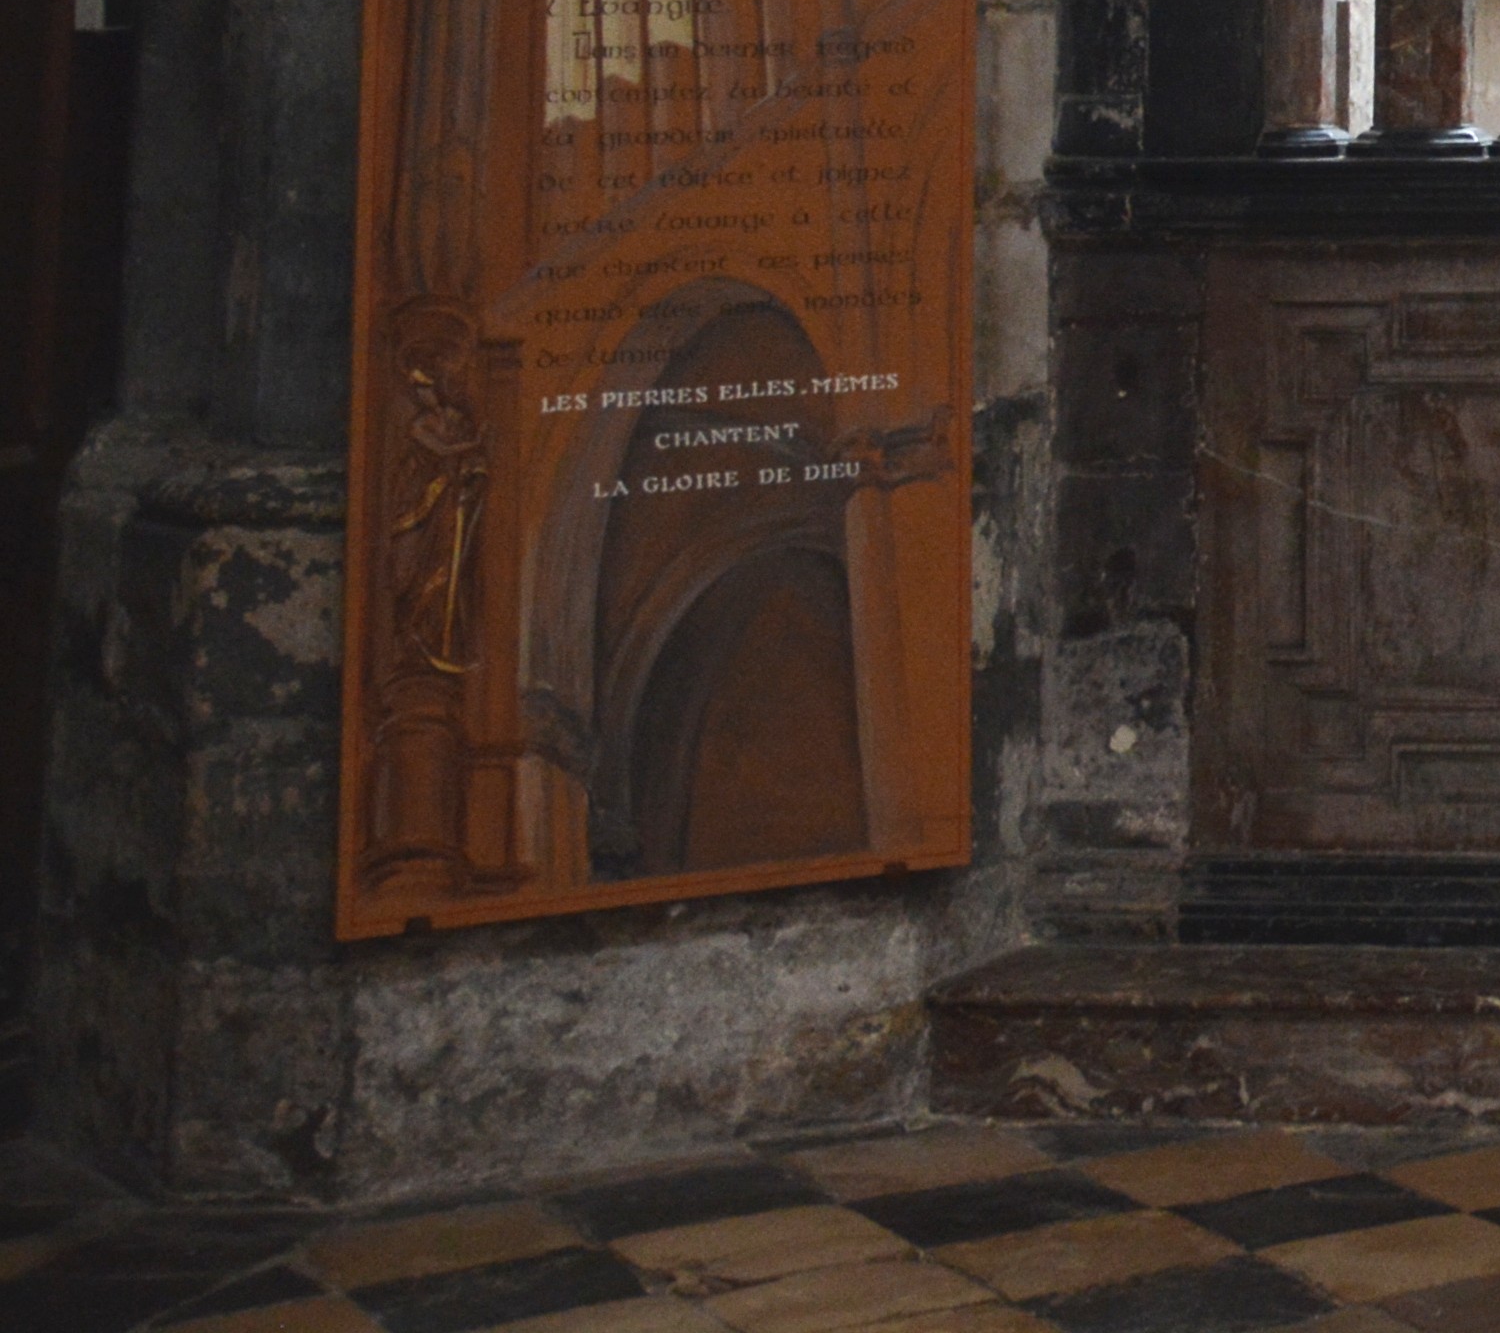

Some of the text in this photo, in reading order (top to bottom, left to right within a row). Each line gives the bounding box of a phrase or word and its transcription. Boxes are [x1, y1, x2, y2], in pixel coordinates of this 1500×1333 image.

[540, 392, 589, 415] LES
[599, 385, 710, 410] PIERRES
[653, 422, 801, 451] CHANTENT
[593, 460, 863, 500] LA GLOIRE DE DIEU
